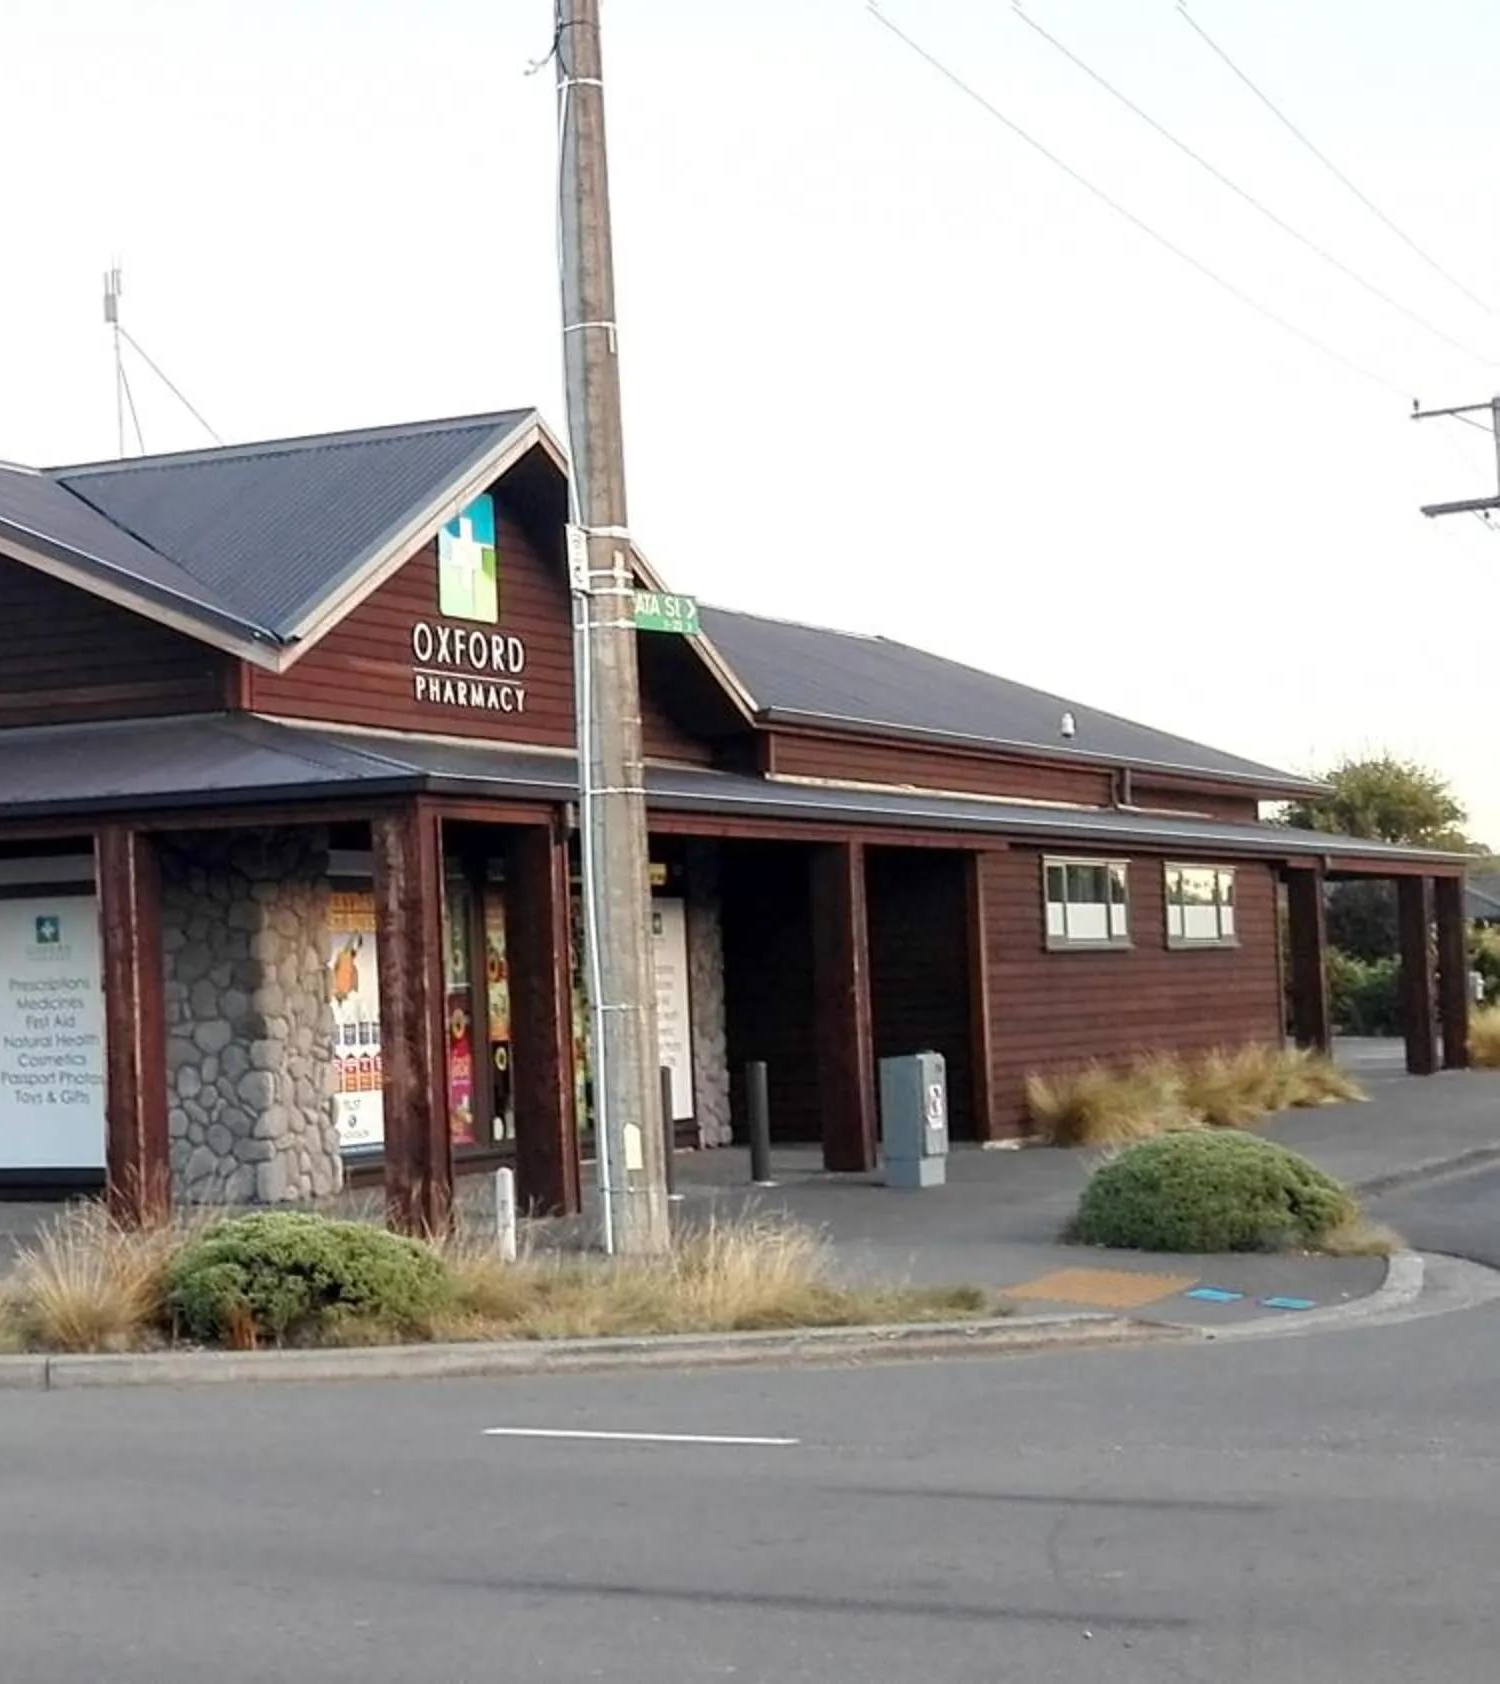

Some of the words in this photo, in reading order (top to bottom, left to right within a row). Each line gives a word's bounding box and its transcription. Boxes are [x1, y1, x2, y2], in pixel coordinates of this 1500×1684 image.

[413, 622, 524, 673] OXFORD
[415, 675, 526, 713] PHARMACY
[8, 978, 90, 992] Prescriptions
[16, 998, 85, 1011] Medicines
[26, 1015, 50, 1029] First
[53, 1014, 76, 1028] Aid
[3, 1035, 52, 1049] Natural
[56, 1033, 99, 1047] Health
[17, 1053, 87, 1067] Cosmetics
[1, 1071, 56, 1086] Passport
[14, 1090, 43, 1105] Toys
[47, 1090, 57, 1104] &
[60, 1089, 90, 1105] Gifts
